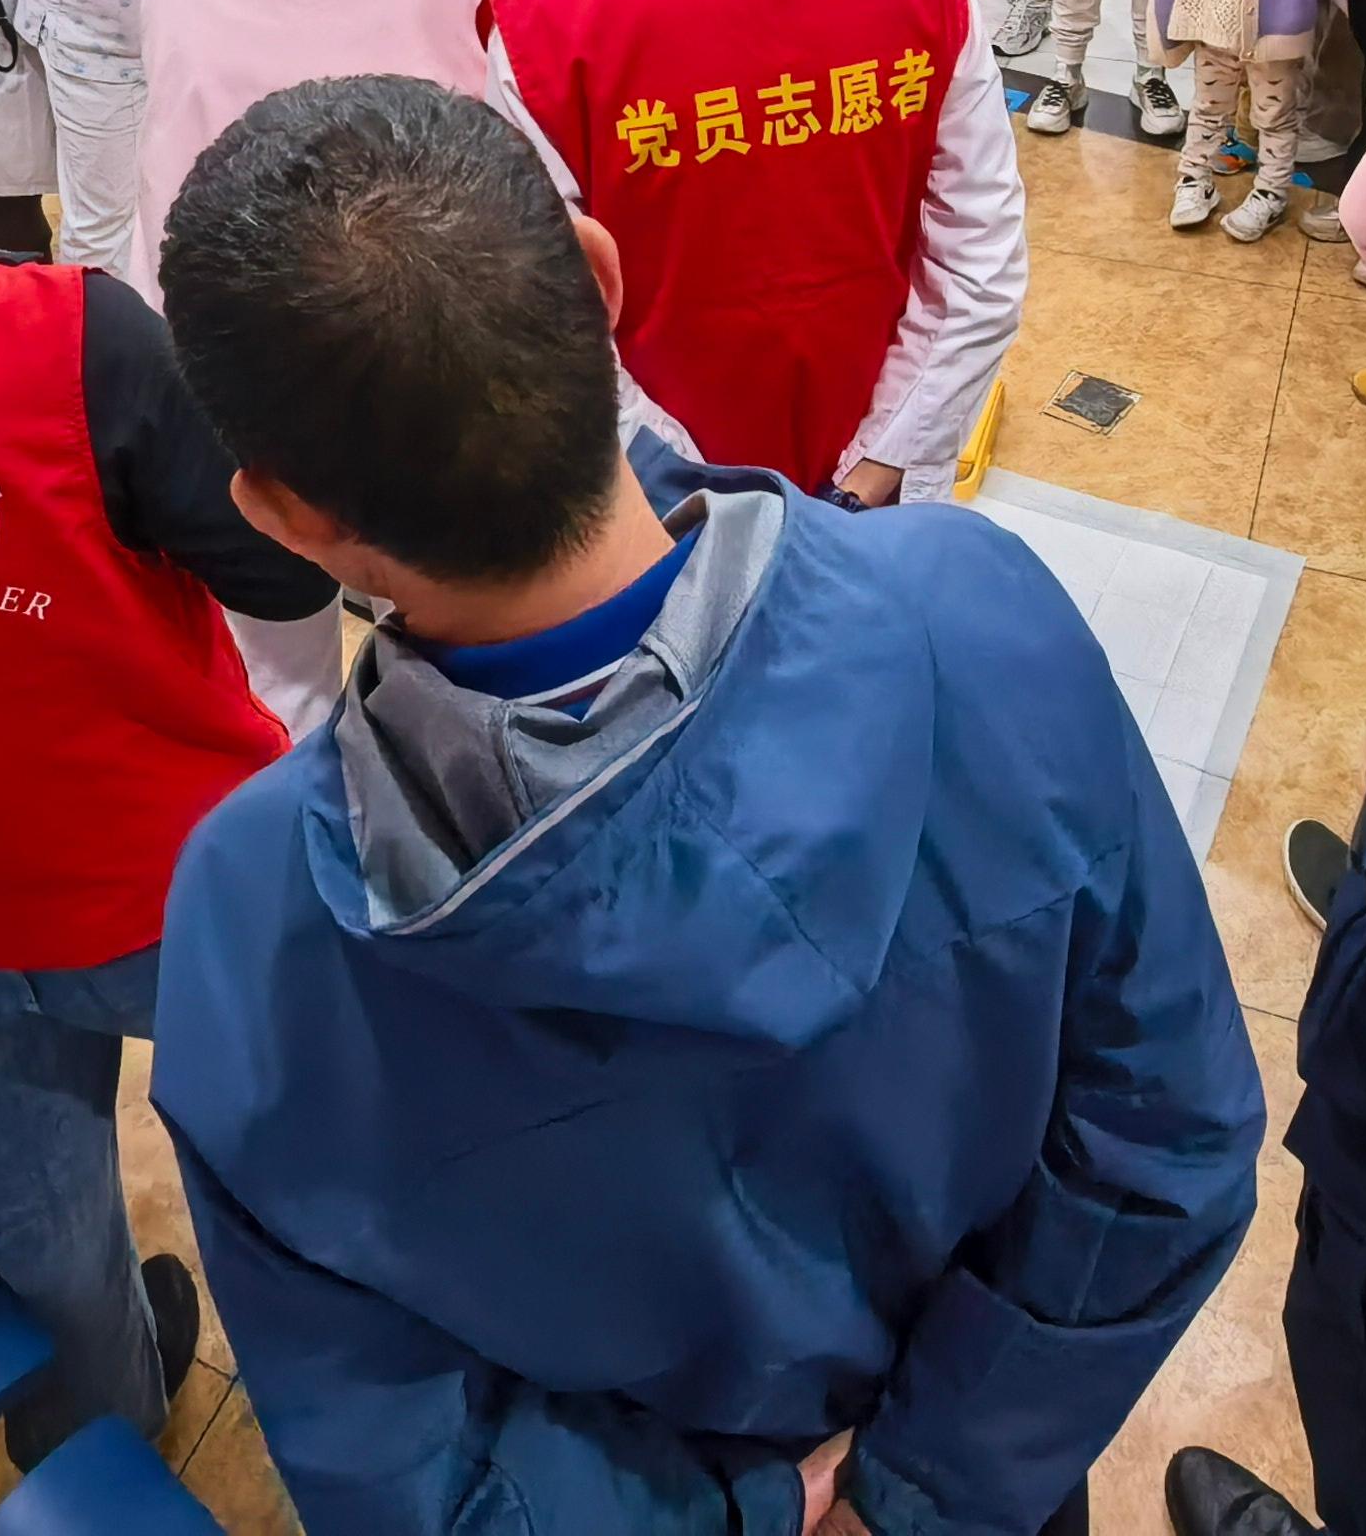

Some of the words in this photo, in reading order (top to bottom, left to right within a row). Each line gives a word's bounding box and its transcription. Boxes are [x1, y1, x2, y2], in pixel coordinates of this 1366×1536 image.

[615, 48, 936, 174] 党员志愿者
